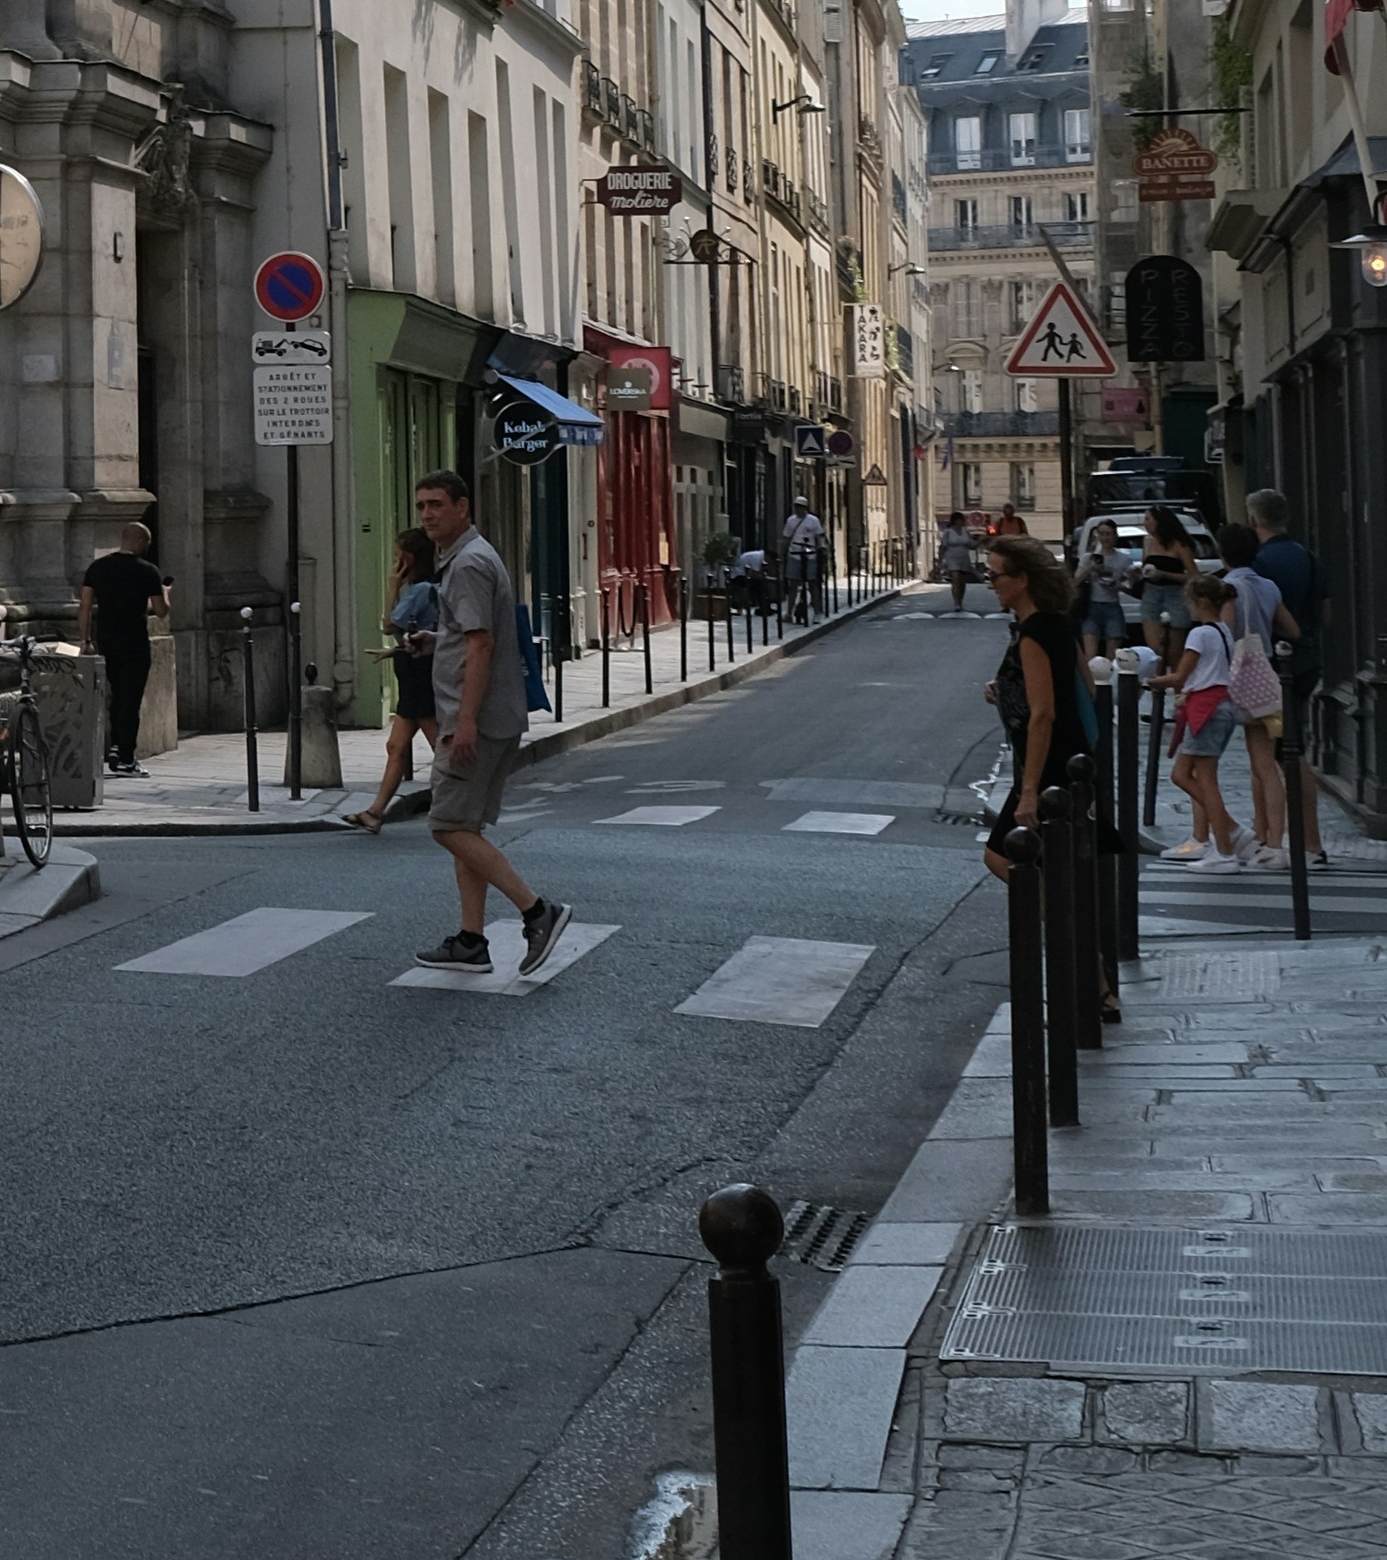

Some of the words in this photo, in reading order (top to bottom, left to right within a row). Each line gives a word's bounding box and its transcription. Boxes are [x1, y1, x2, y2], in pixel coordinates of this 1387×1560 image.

[1141, 156, 1208, 169] BANETTE
[607, 172, 672, 190] DROGUERIE
[1138, 269, 1162, 357] PIZZA
[1171, 269, 1194, 358] RESTO
[858, 305, 868, 363] TAKARA
[258, 384, 327, 393] STATIONNEMENT
[259, 397, 278, 405] DES
[293, 396, 326, 404] ROUES
[289, 408, 330, 416] TROTTOIR
[504, 420, 546, 434] Kebab
[263, 432, 274, 440] ET
